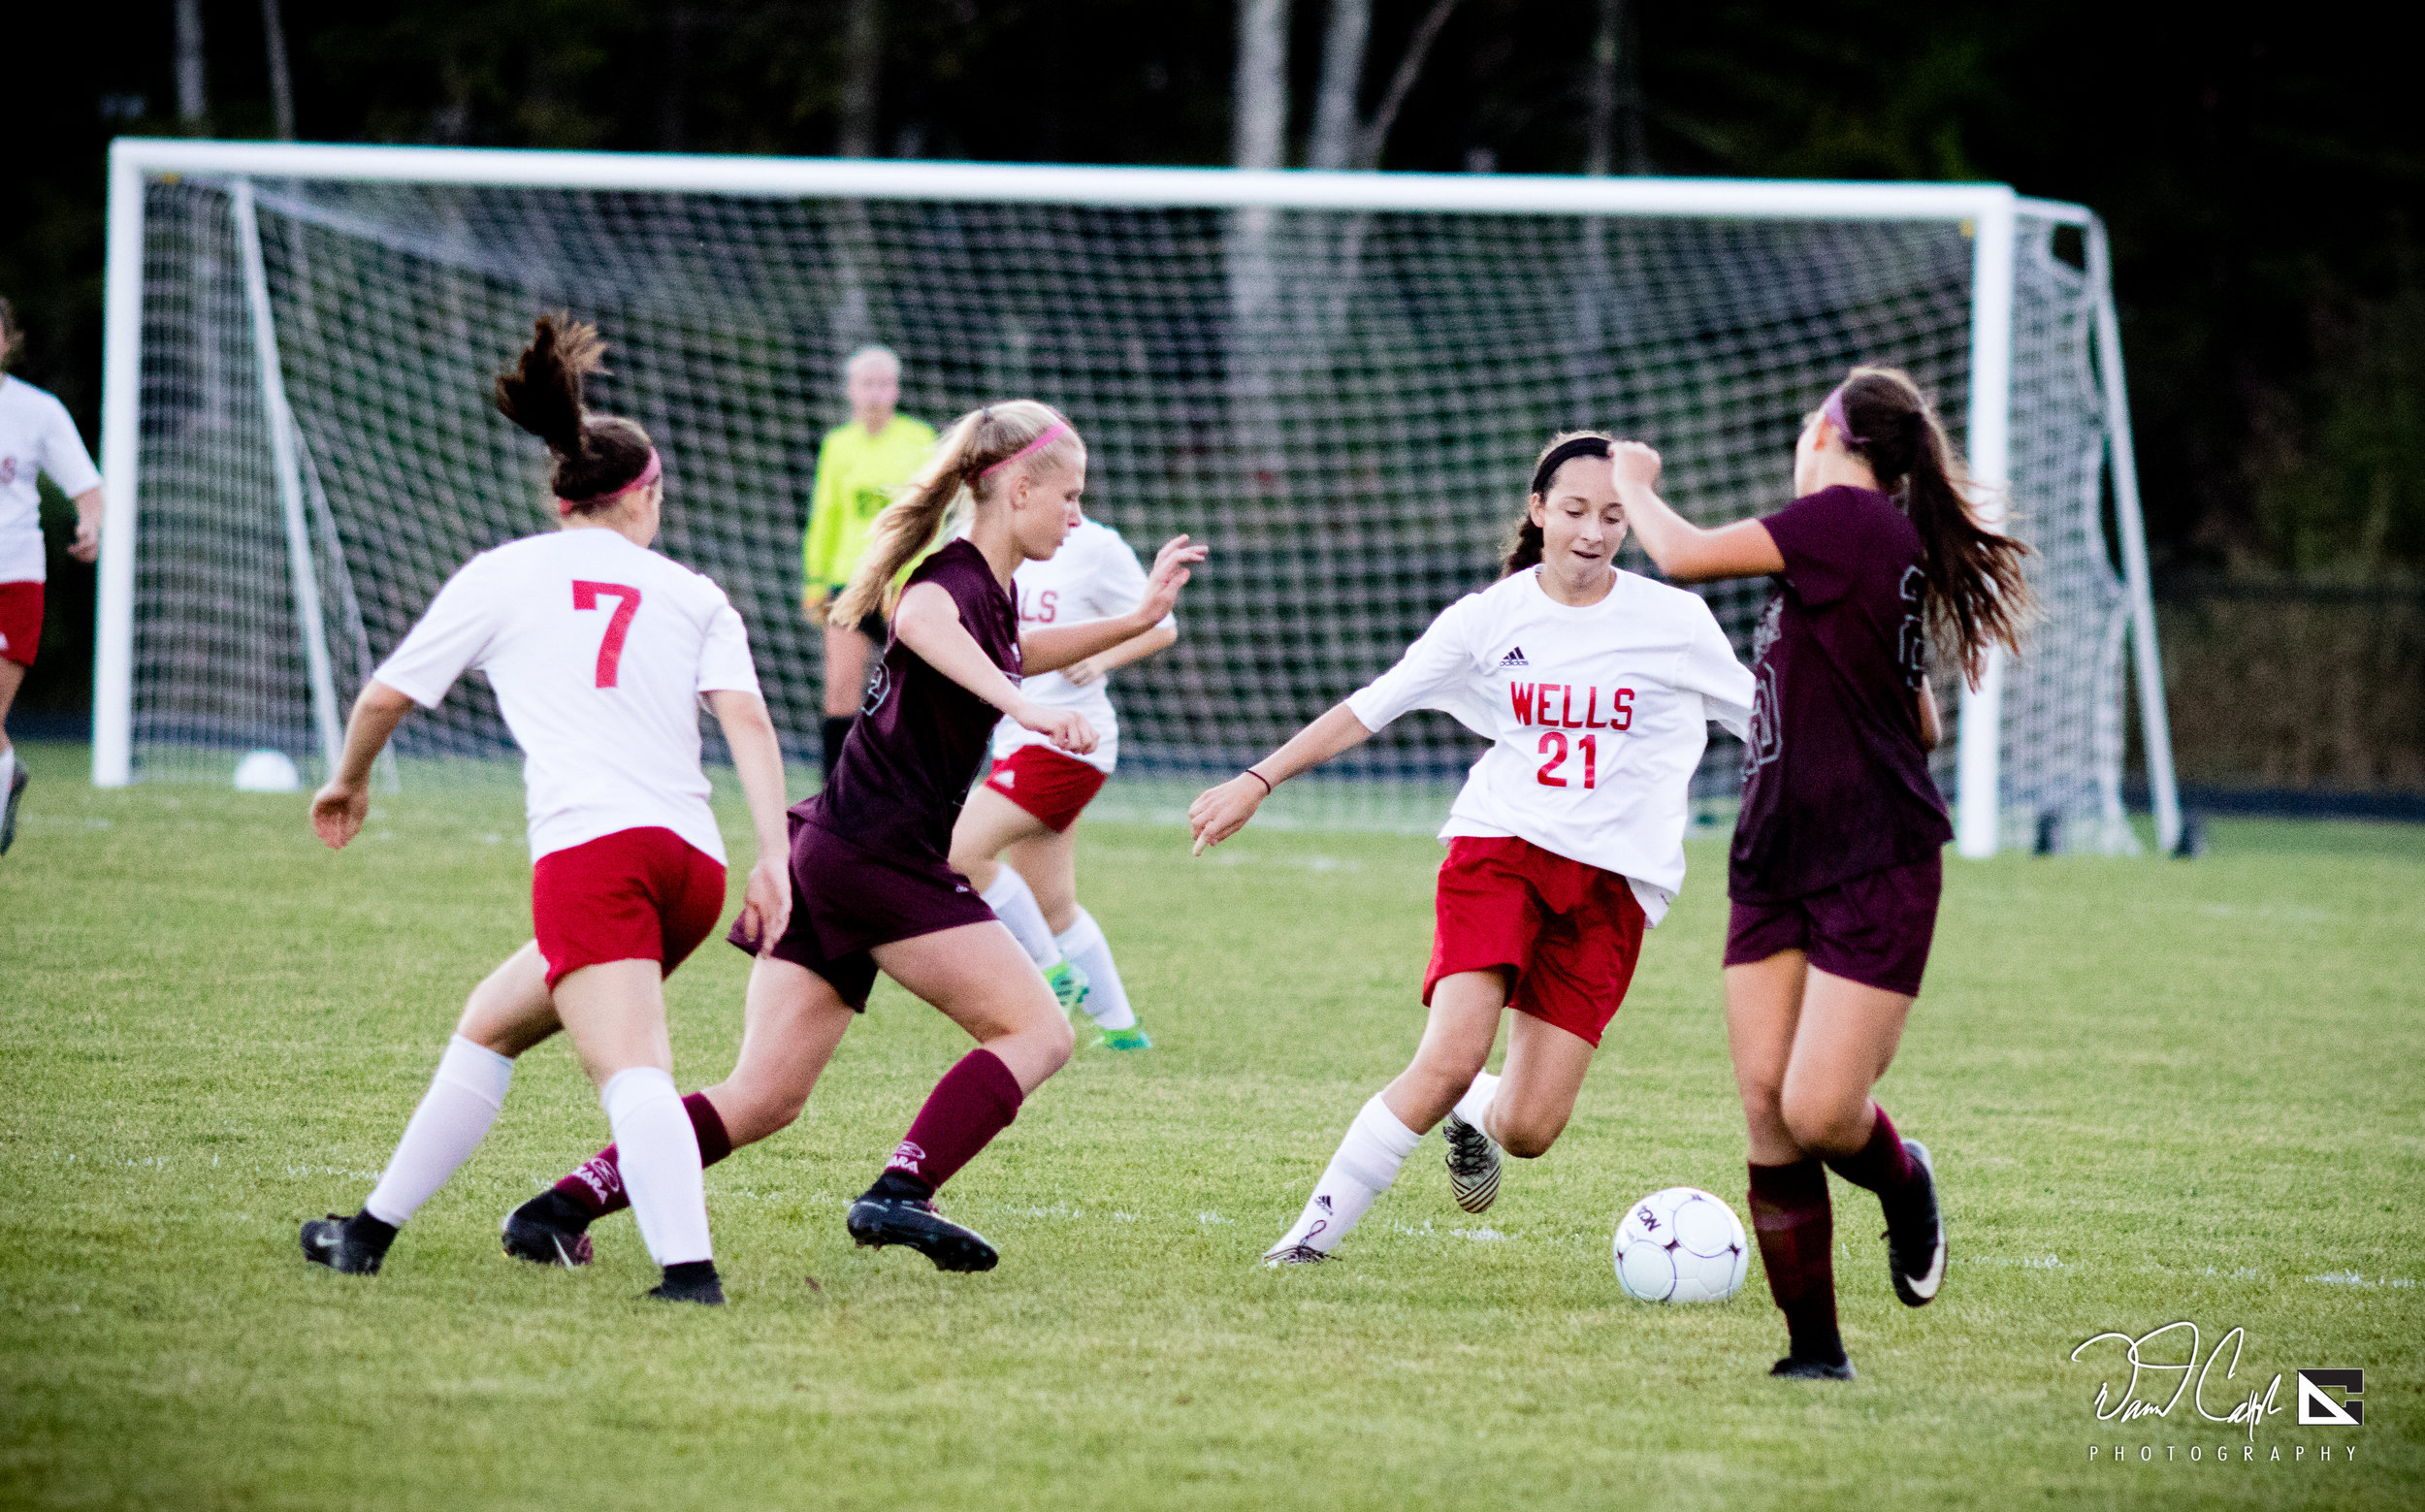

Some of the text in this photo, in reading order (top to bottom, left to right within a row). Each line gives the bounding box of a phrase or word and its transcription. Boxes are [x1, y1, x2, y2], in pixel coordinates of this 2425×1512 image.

[571, 580, 641, 688] 7
[1510, 681, 1635, 730] WELLS
[1536, 731, 1597, 789] 21
